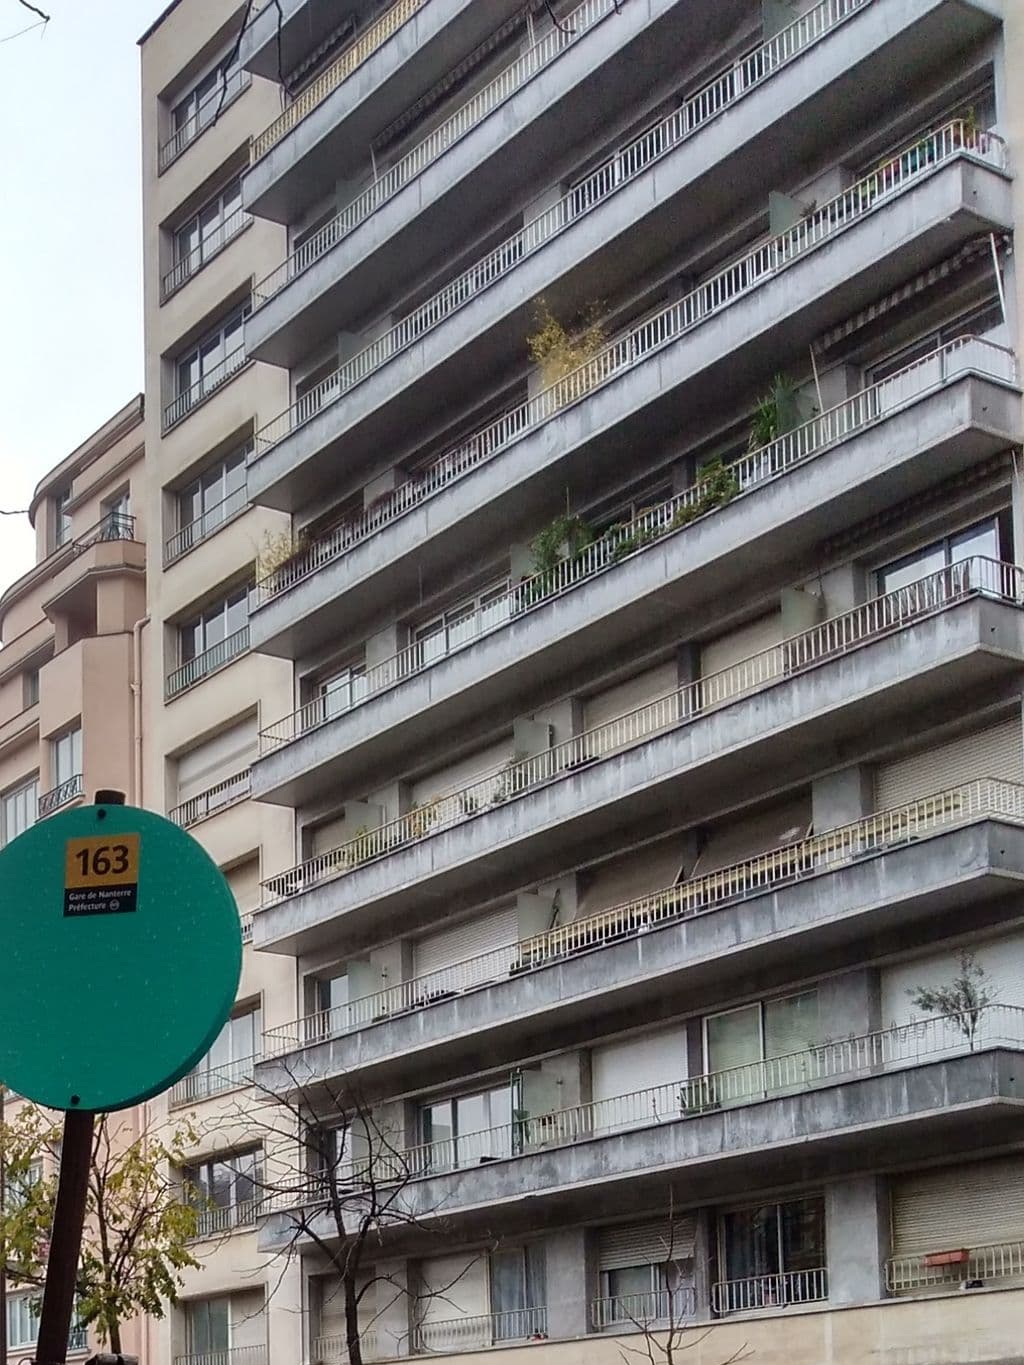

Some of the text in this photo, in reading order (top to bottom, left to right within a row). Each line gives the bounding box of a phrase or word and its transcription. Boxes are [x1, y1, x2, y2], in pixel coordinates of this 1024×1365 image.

[76, 844, 129, 876] 163
[69, 889, 132, 901] Gare de Nanterre
[68, 902, 106, 912] Préfecture
